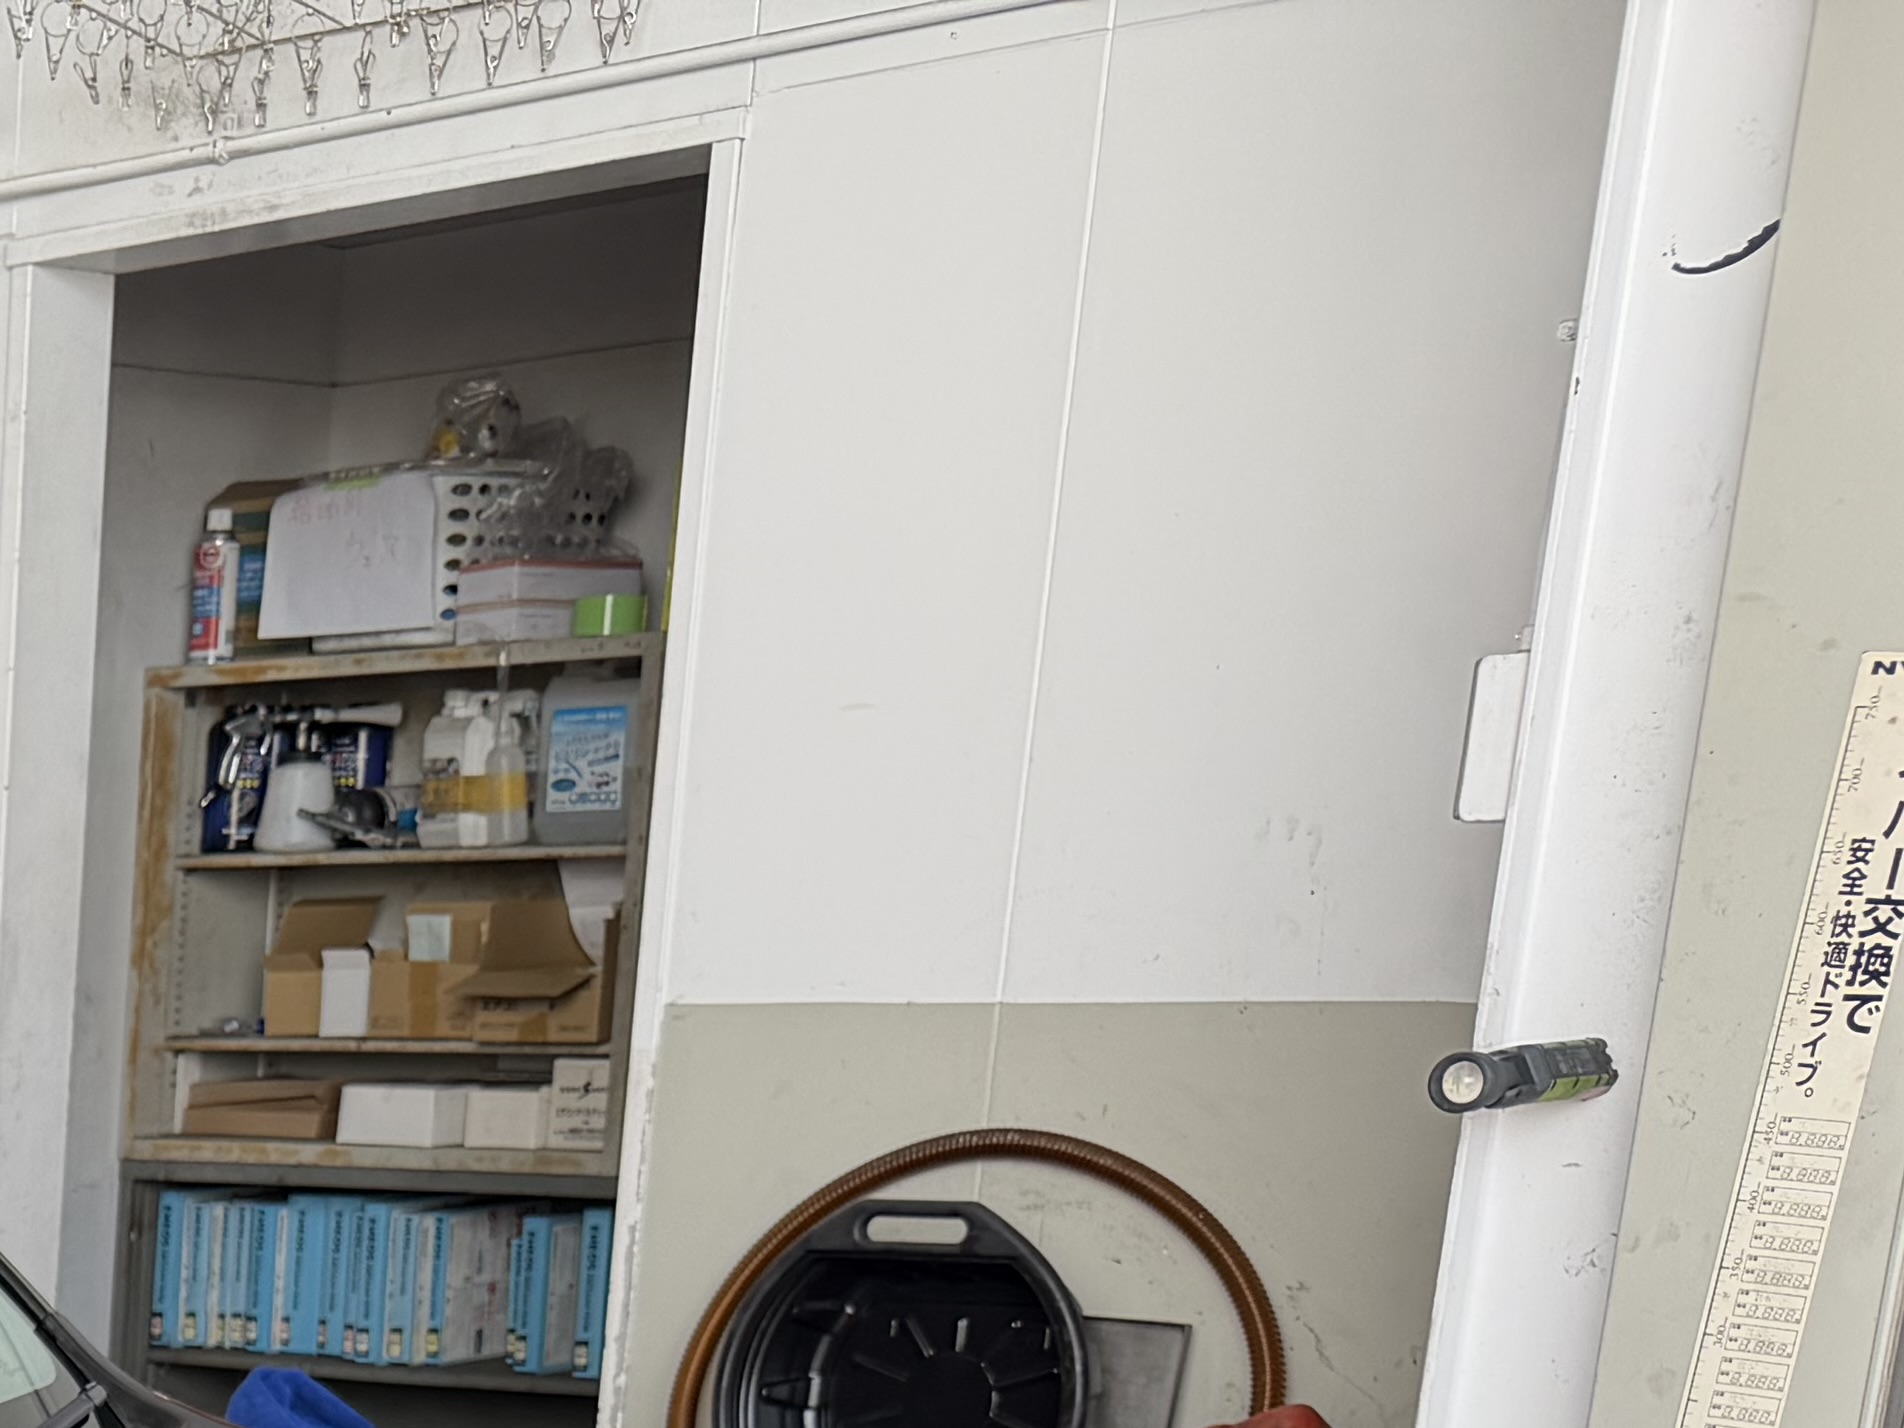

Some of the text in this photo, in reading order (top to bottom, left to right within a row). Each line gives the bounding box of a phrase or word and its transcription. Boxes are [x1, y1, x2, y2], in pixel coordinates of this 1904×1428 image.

[1848, 767, 1863, 793] 700
[1815, 910, 1828, 936] 600
[1794, 836, 1877, 1099] 安全・快適ドライブ。
[1797, 980, 1811, 1006] 550
[1780, 1052, 1794, 1077] 500
[1747, 1189, 1761, 1213] 400
